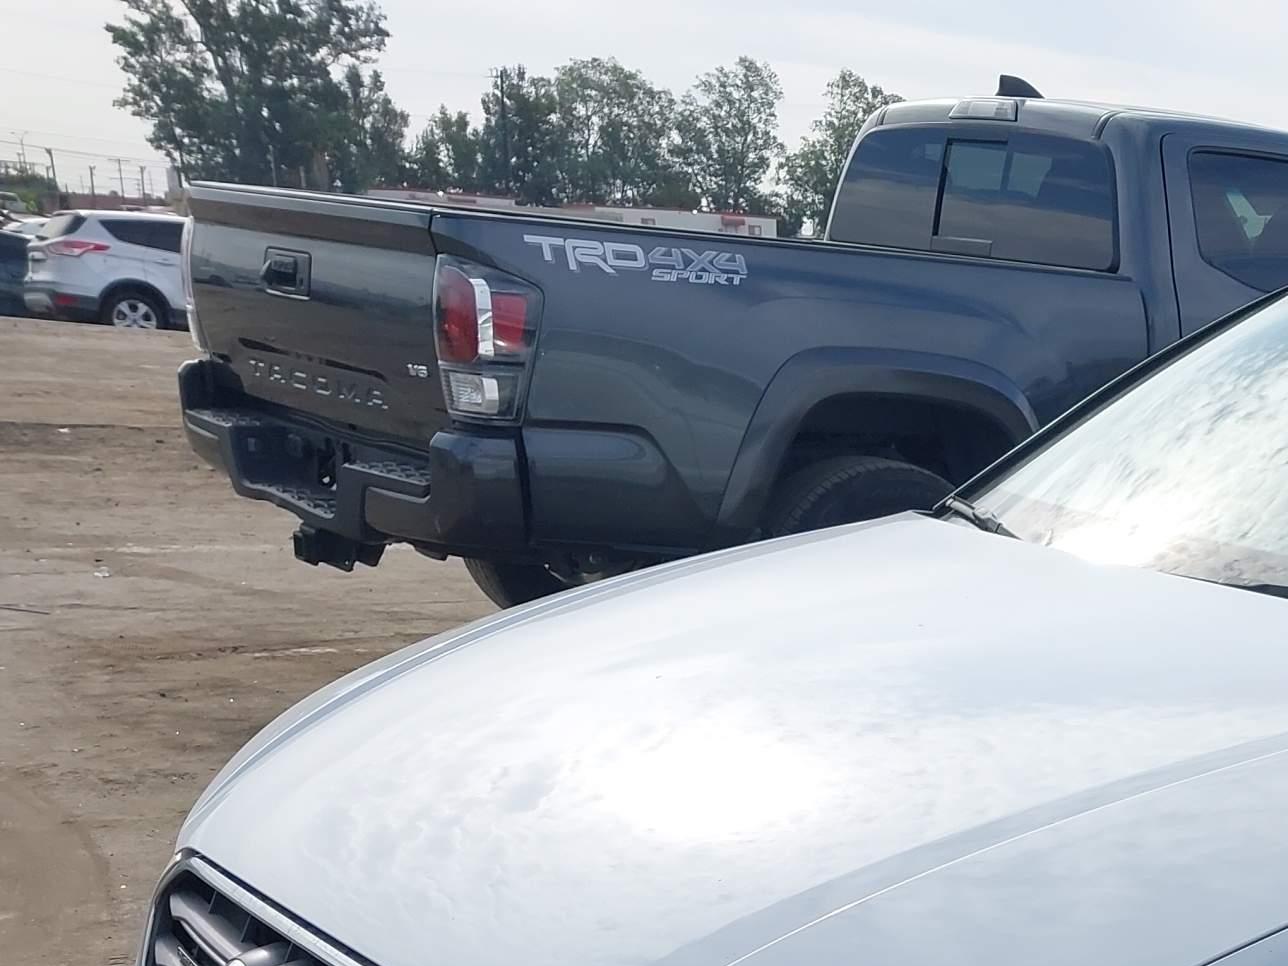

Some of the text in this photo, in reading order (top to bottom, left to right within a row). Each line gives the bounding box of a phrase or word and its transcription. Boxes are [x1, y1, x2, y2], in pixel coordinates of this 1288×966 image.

[523, 234, 748, 276] TRD 4X4
[651, 268, 747, 285] SPORT
[248, 357, 389, 410] TACOMA
[406, 362, 429, 379] V6
